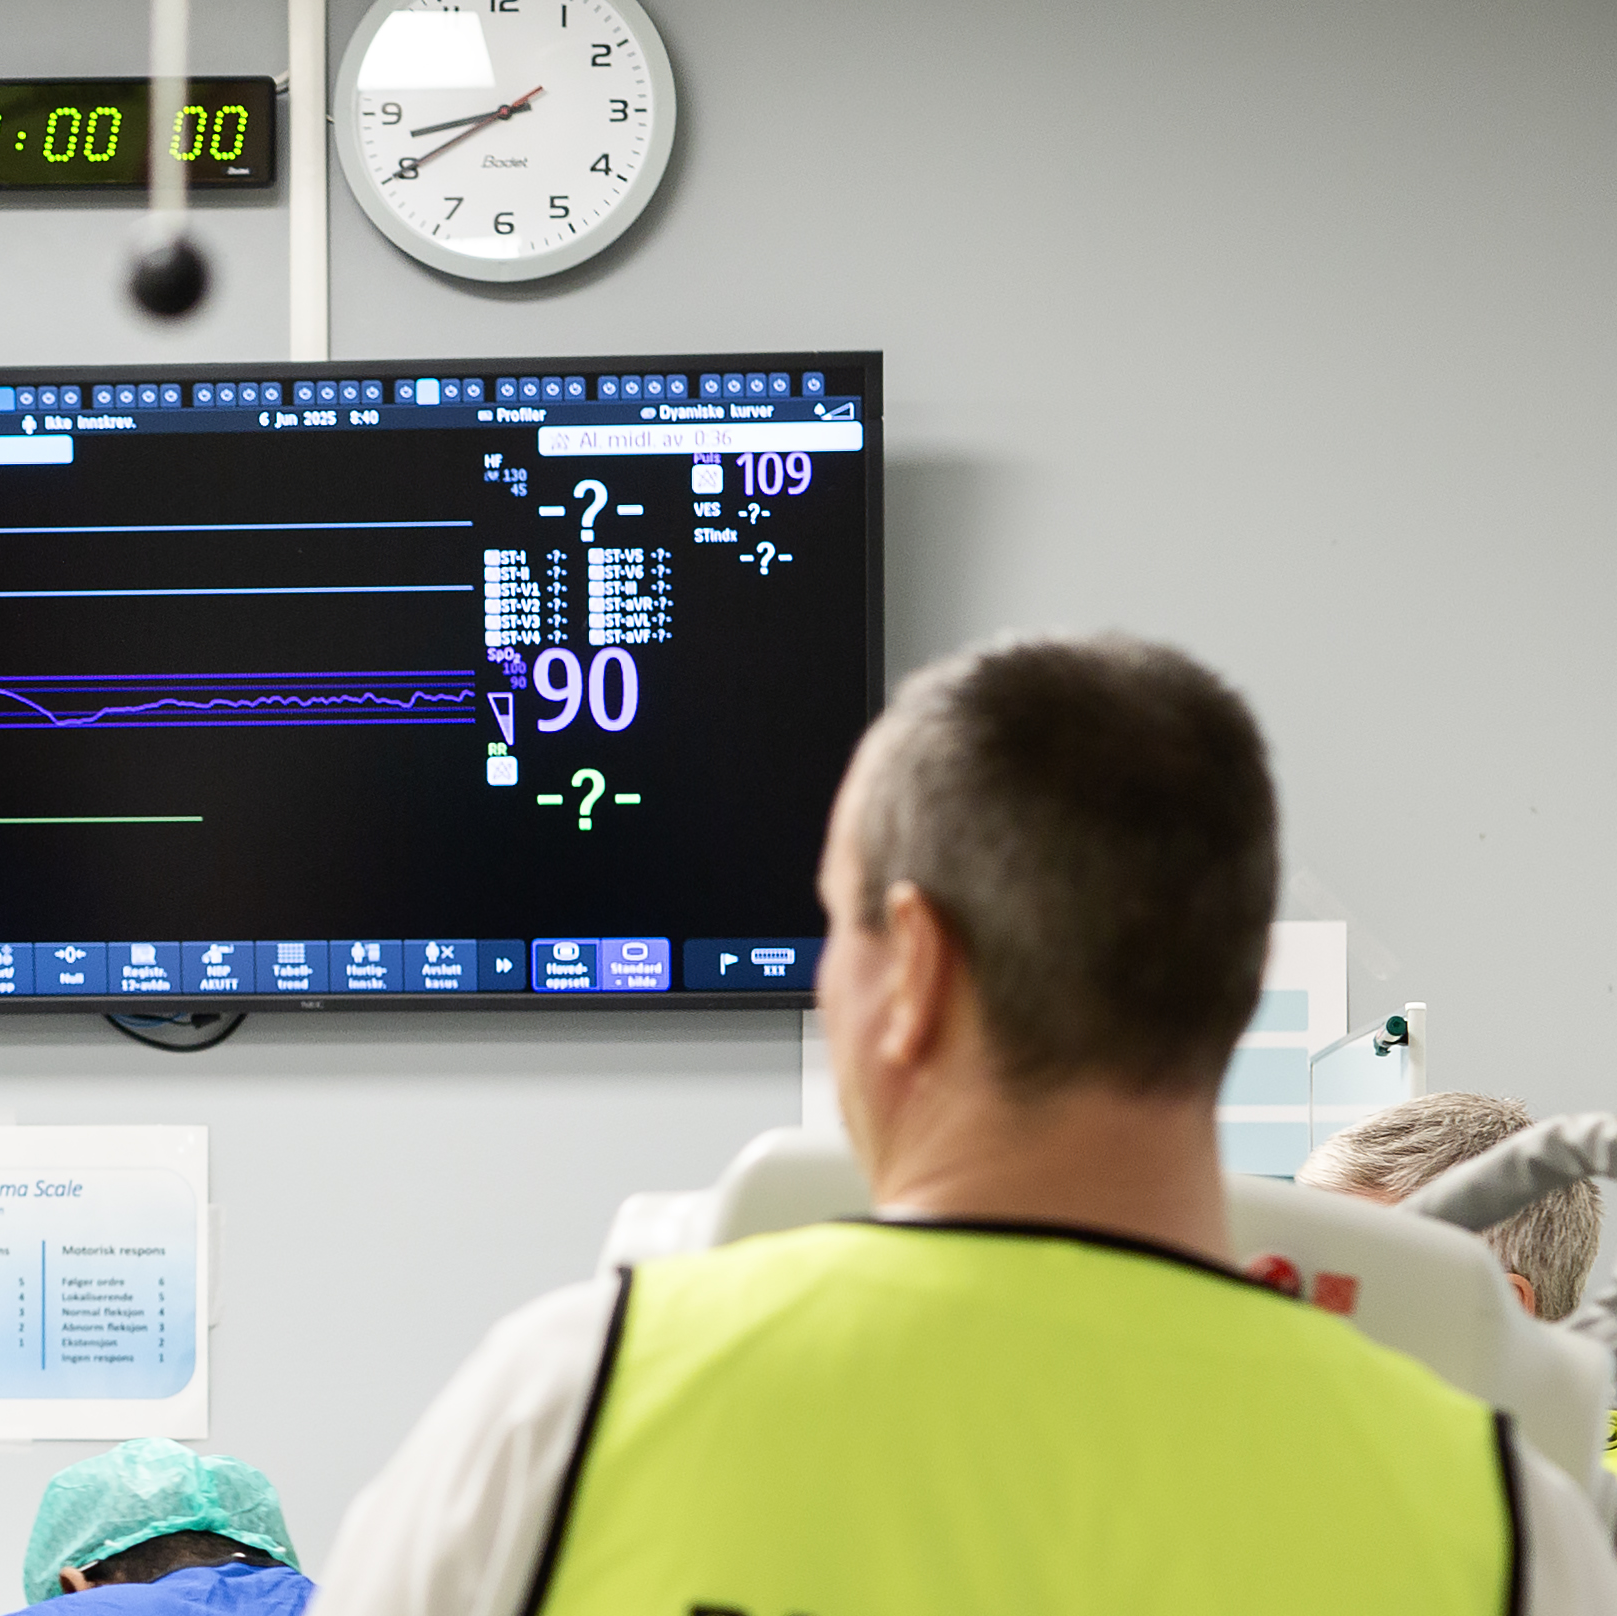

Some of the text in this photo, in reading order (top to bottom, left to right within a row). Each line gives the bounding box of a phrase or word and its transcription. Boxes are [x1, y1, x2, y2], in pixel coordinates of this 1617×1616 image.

[561, 5, 567, 28] 1
[591, 44, 612, 67] 2
[381, 102, 402, 125] 9
[609, 100, 628, 122] 3
[169, 105, 249, 162] 00
[481, 156, 529, 169] Bodet
[590, 154, 612, 176] 4
[444, 197, 464, 220] 7
[549, 196, 569, 219] 5
[493, 212, 514, 235] 6
[258, 411, 269, 427] 6
[303, 410, 337, 426] 2025
[496, 408, 547, 423] Profiler
[730, 404, 775, 419] kurver
[663, 434, 683, 447] av
[503, 469, 528, 482] 130
[736, 451, 812, 496] 109
[694, 503, 721, 517] VES
[532, 646, 639, 733] 90
[33, 1179, 83, 1197] Scale
